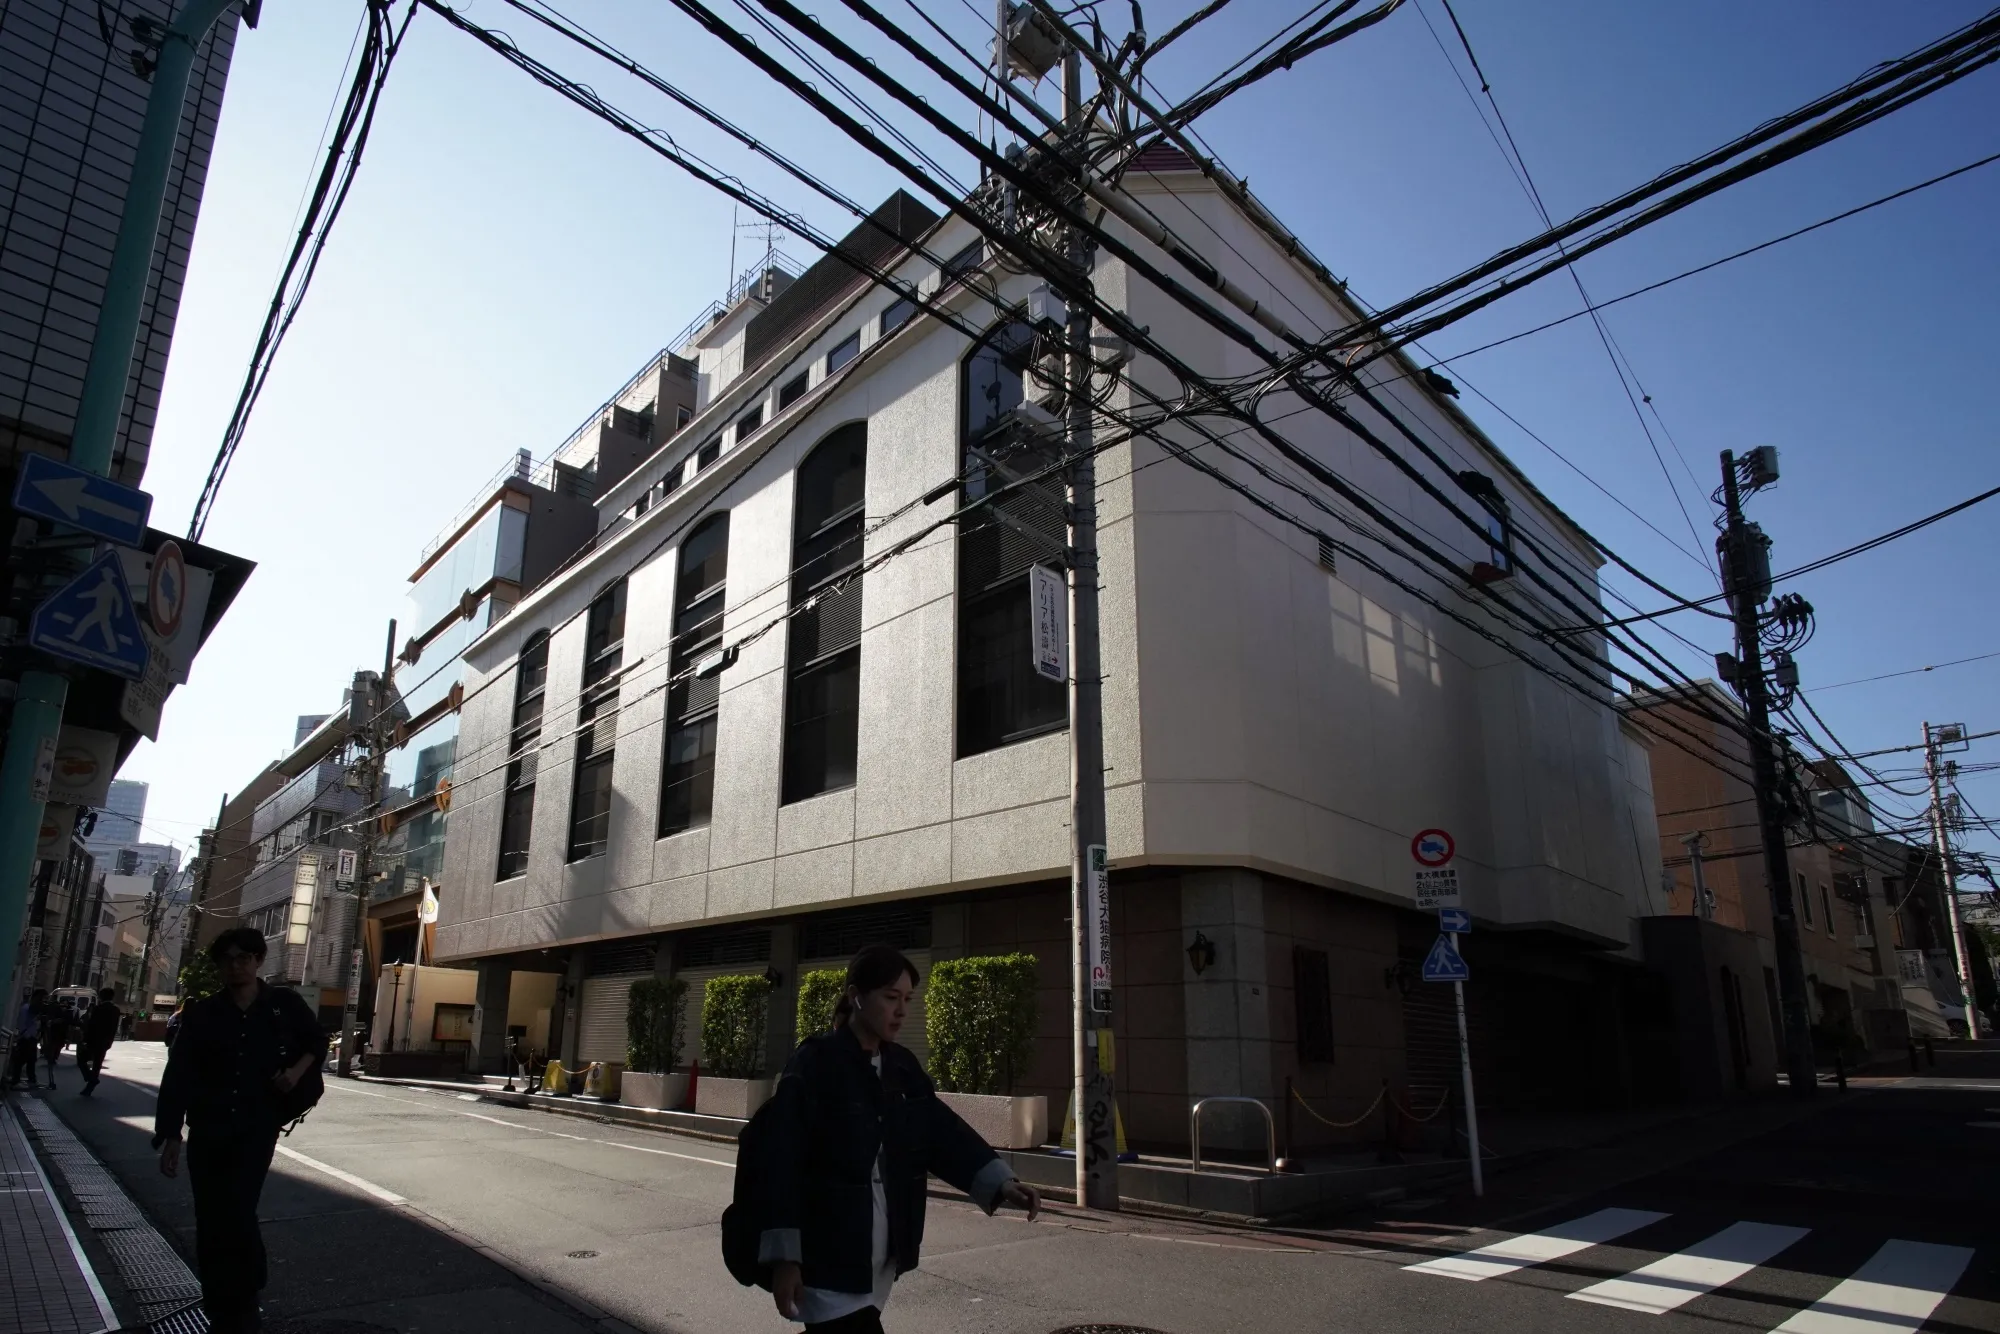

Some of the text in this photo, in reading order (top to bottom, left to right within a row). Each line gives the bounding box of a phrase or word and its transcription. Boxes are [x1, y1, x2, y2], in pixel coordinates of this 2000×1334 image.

[1416, 870, 1455, 880] 最大積載量
[1418, 898, 1440, 907] を除く
